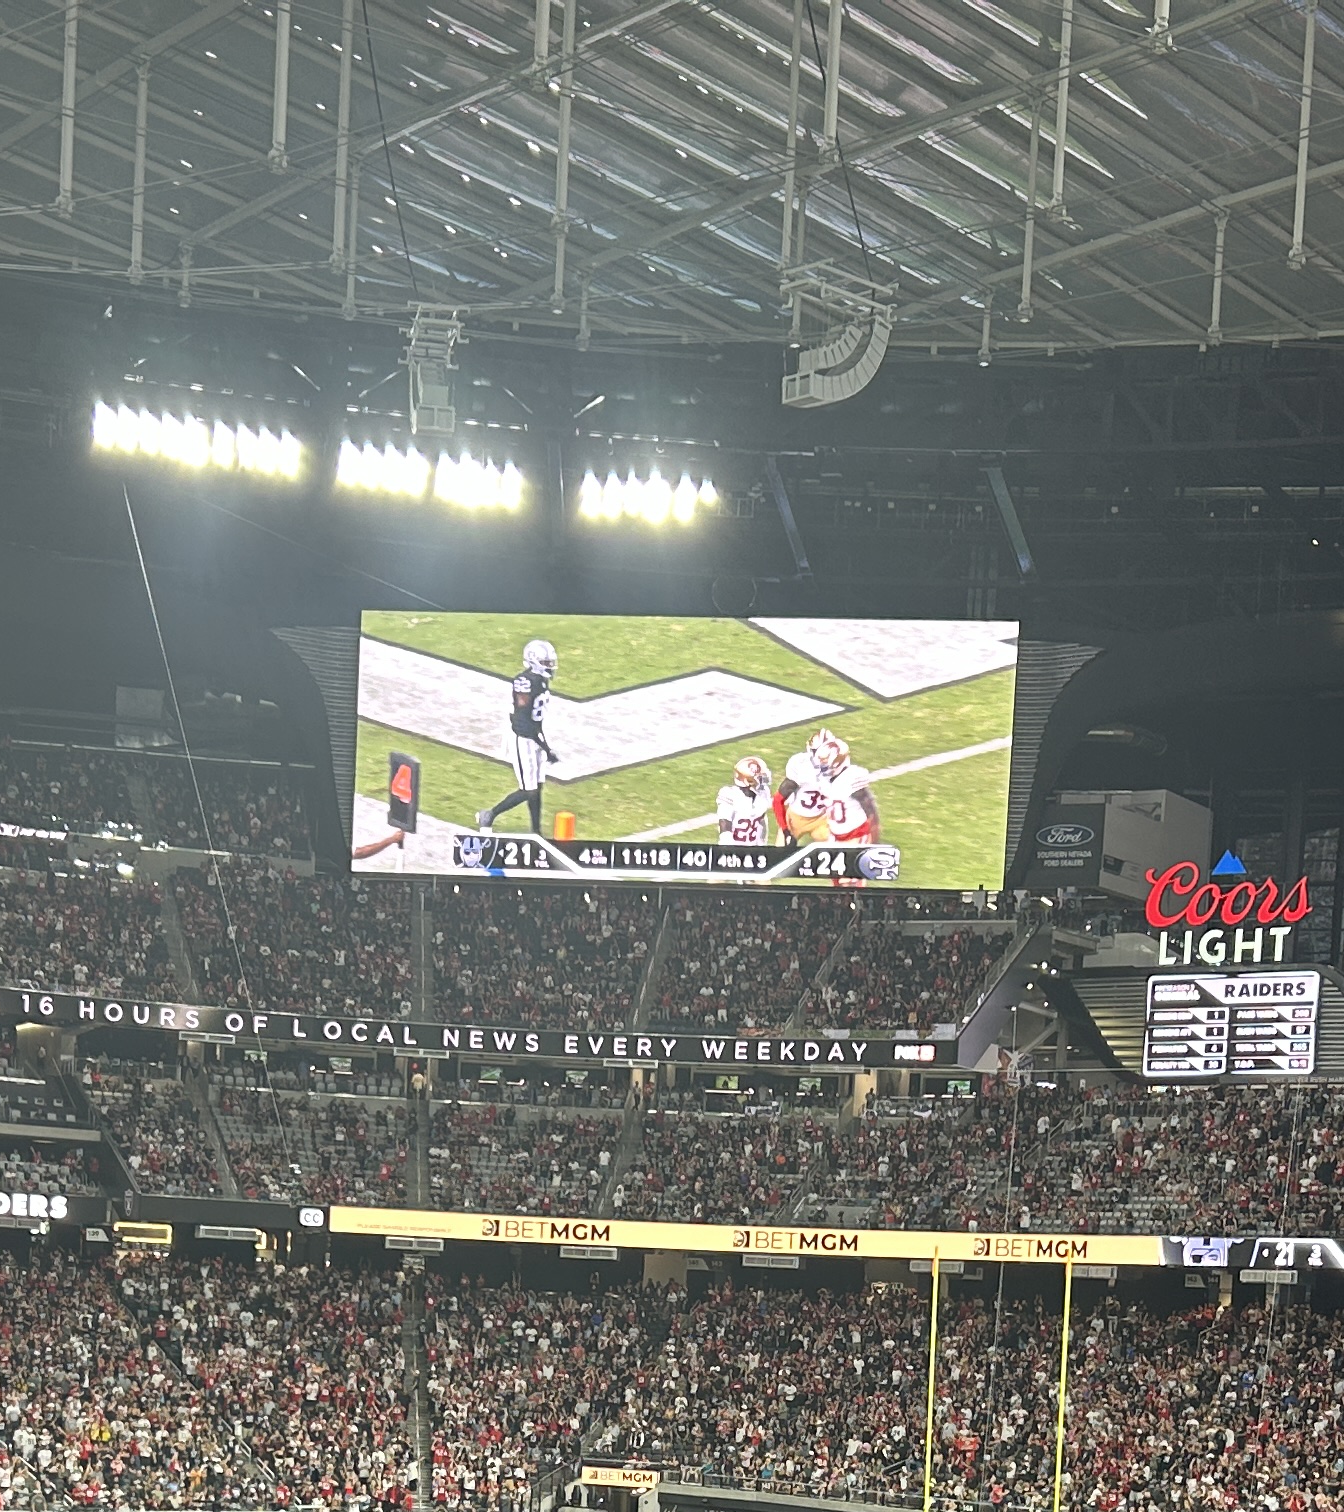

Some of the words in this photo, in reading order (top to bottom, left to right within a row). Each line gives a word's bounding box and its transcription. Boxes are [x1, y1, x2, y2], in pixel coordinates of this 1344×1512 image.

[1046, 826, 1083, 844] Ford
[504, 842, 531, 863] 21
[621, 849, 670, 866] 11:18
[681, 850, 707, 867] 40
[816, 851, 846, 876] 24
[1144, 861, 1313, 928] Coors
[1158, 926, 1292, 967] LIGHT
[1224, 982, 1306, 998] RAIDERS
[20, 994, 55, 1016] 16
[78, 1000, 200, 1028] HOURS
[225, 1014, 268, 1034] OF
[293, 1019, 418, 1046] LOCAL
[442, 1029, 540, 1053] NEWS
[564, 1034, 678, 1059] EVERY
[702, 1038, 869, 1063] WEEKDAY
[303, 1212, 321, 1224] CC
[504, 1220, 611, 1242] BETMGM
[755, 1231, 858, 1252] BETMGM
[995, 1238, 1088, 1258] BETMGM
[1276, 1242, 1295, 1267] 21
[599, 1470, 653, 1482] BETMGM
